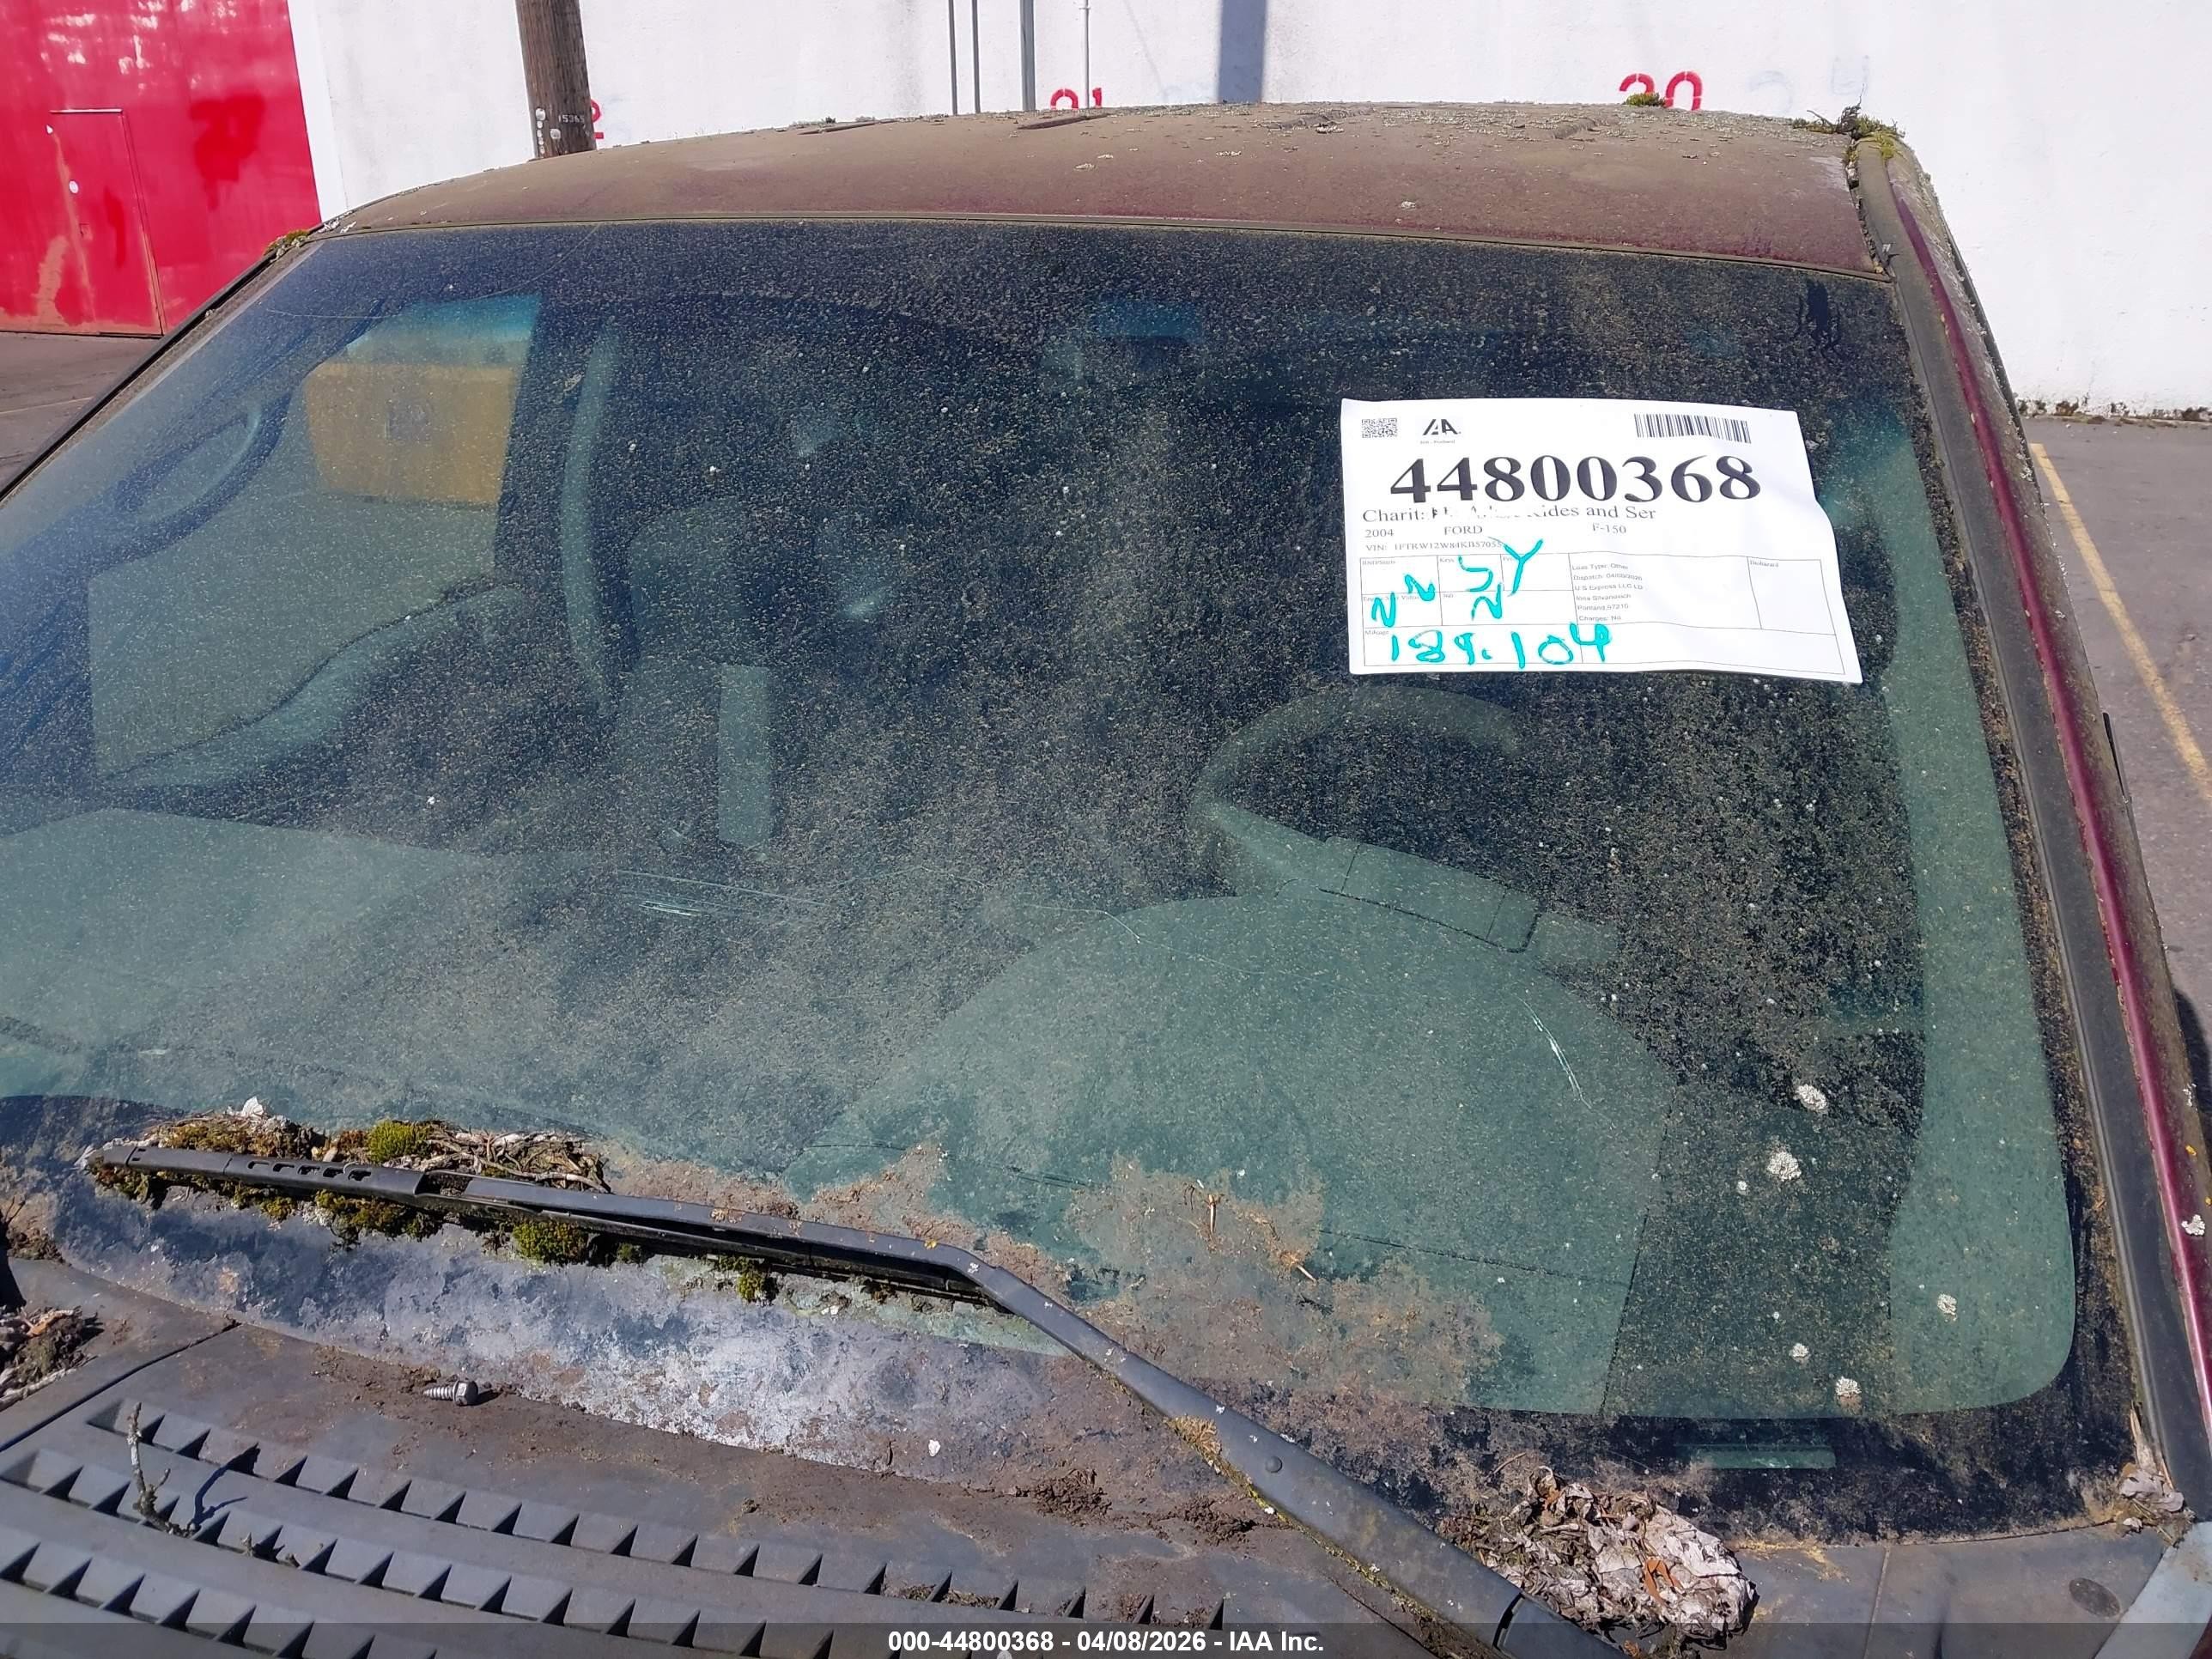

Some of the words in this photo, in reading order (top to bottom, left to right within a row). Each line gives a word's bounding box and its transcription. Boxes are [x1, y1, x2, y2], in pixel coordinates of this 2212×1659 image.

[1390, 455, 1761, 503] 44800368
[1362, 507, 1425, 523] Charit:
[1586, 505, 1619, 519] and
[1626, 505, 1656, 520] Ser
[1364, 528, 1395, 538] 2004
[1443, 525, 1483, 536] FORD
[1592, 522, 1626, 534] F-150
[1365, 544, 1388, 552] VIN:
